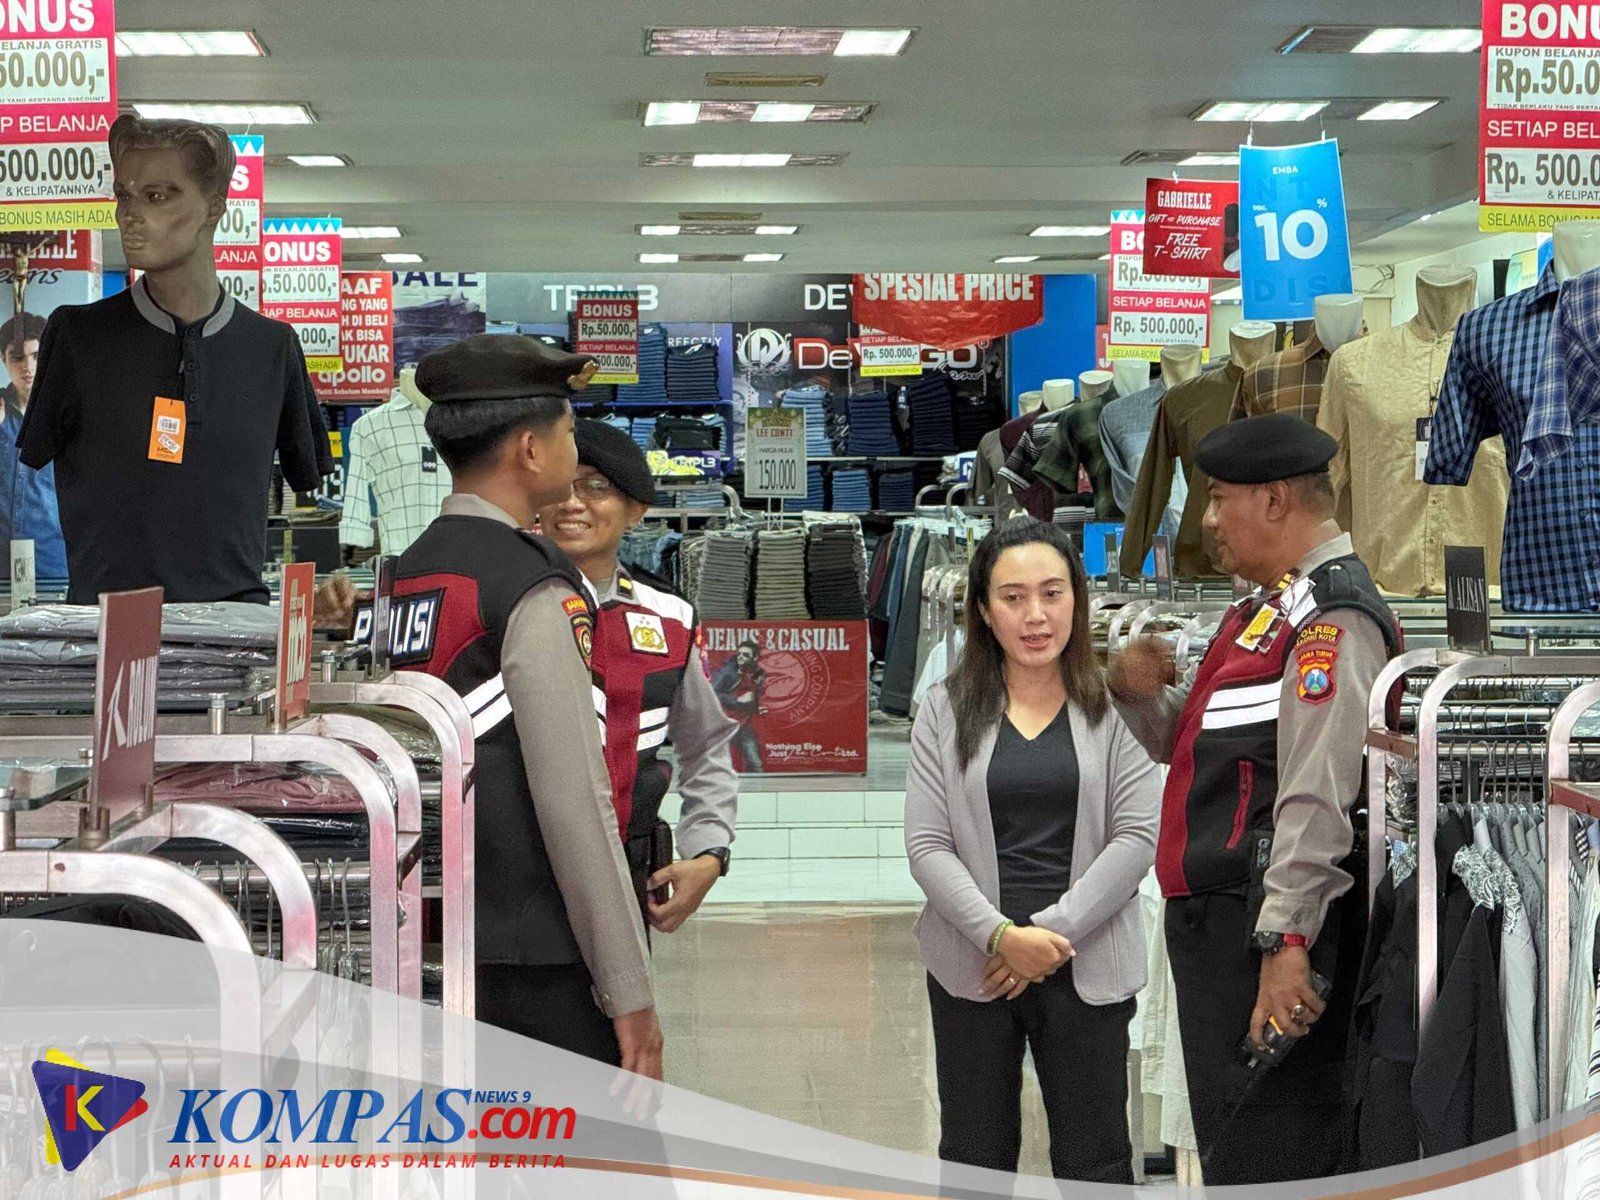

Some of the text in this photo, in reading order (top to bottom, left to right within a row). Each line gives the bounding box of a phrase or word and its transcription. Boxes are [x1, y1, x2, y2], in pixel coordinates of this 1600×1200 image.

[0, 0, 94, 32] NUS
[56, 40, 102, 49] GRATIS
[1495, 48, 1540, 57] KUPON
[19, 115, 110, 133] BELANJA
[1487, 120, 1558, 137] SETIAP
[1272, 166, 1298, 175] EMBA
[1486, 153, 1526, 193] Rp.
[6, 185, 95, 196] & KELIPATANNYA
[1547, 190, 1554, 200] &
[1157, 190, 1212, 210] GABRIELLE
[46, 211, 85, 224] MASIH
[88, 210, 113, 223] ADA
[1148, 213, 1168, 224] GIFT
[1176, 215, 1222, 226] PURCHASE
[1487, 213, 1536, 227] SELAMA
[1254, 209, 1328, 261] 10
[1316, 198, 1328, 209] %
[1166, 232, 1202, 247] FREE
[864, 273, 1034, 301] SPESIAL PRICE
[804, 284, 853, 310] DE
[1112, 296, 1206, 309] SETIAP BELANJA
[360, 299, 388, 310] YANG
[582, 304, 633, 317] BONUS
[286, 308, 338, 318] BELANJA
[352, 315, 363, 326] DI
[366, 315, 388, 326] BELI
[581, 323, 636, 338] Rp.50.000,-
[1113, 316, 1203, 339] Rp. 500.000,-
[356, 330, 384, 341] BISA
[861, 336, 886, 344] SETIAP
[579, 344, 636, 353] SETIAP BELANJA
[863, 347, 918, 360] Rp. 500.000,-
[1112, 350, 1139, 359] SELAMA
[318, 366, 386, 387] apollo
[756, 429, 793, 437] LEE CONTI
[759, 459, 797, 490] 150.000
[706, 628, 760, 650] JEANS
[778, 628, 850, 651] CASUAL
[765, 743, 822, 752] Nothing Else
